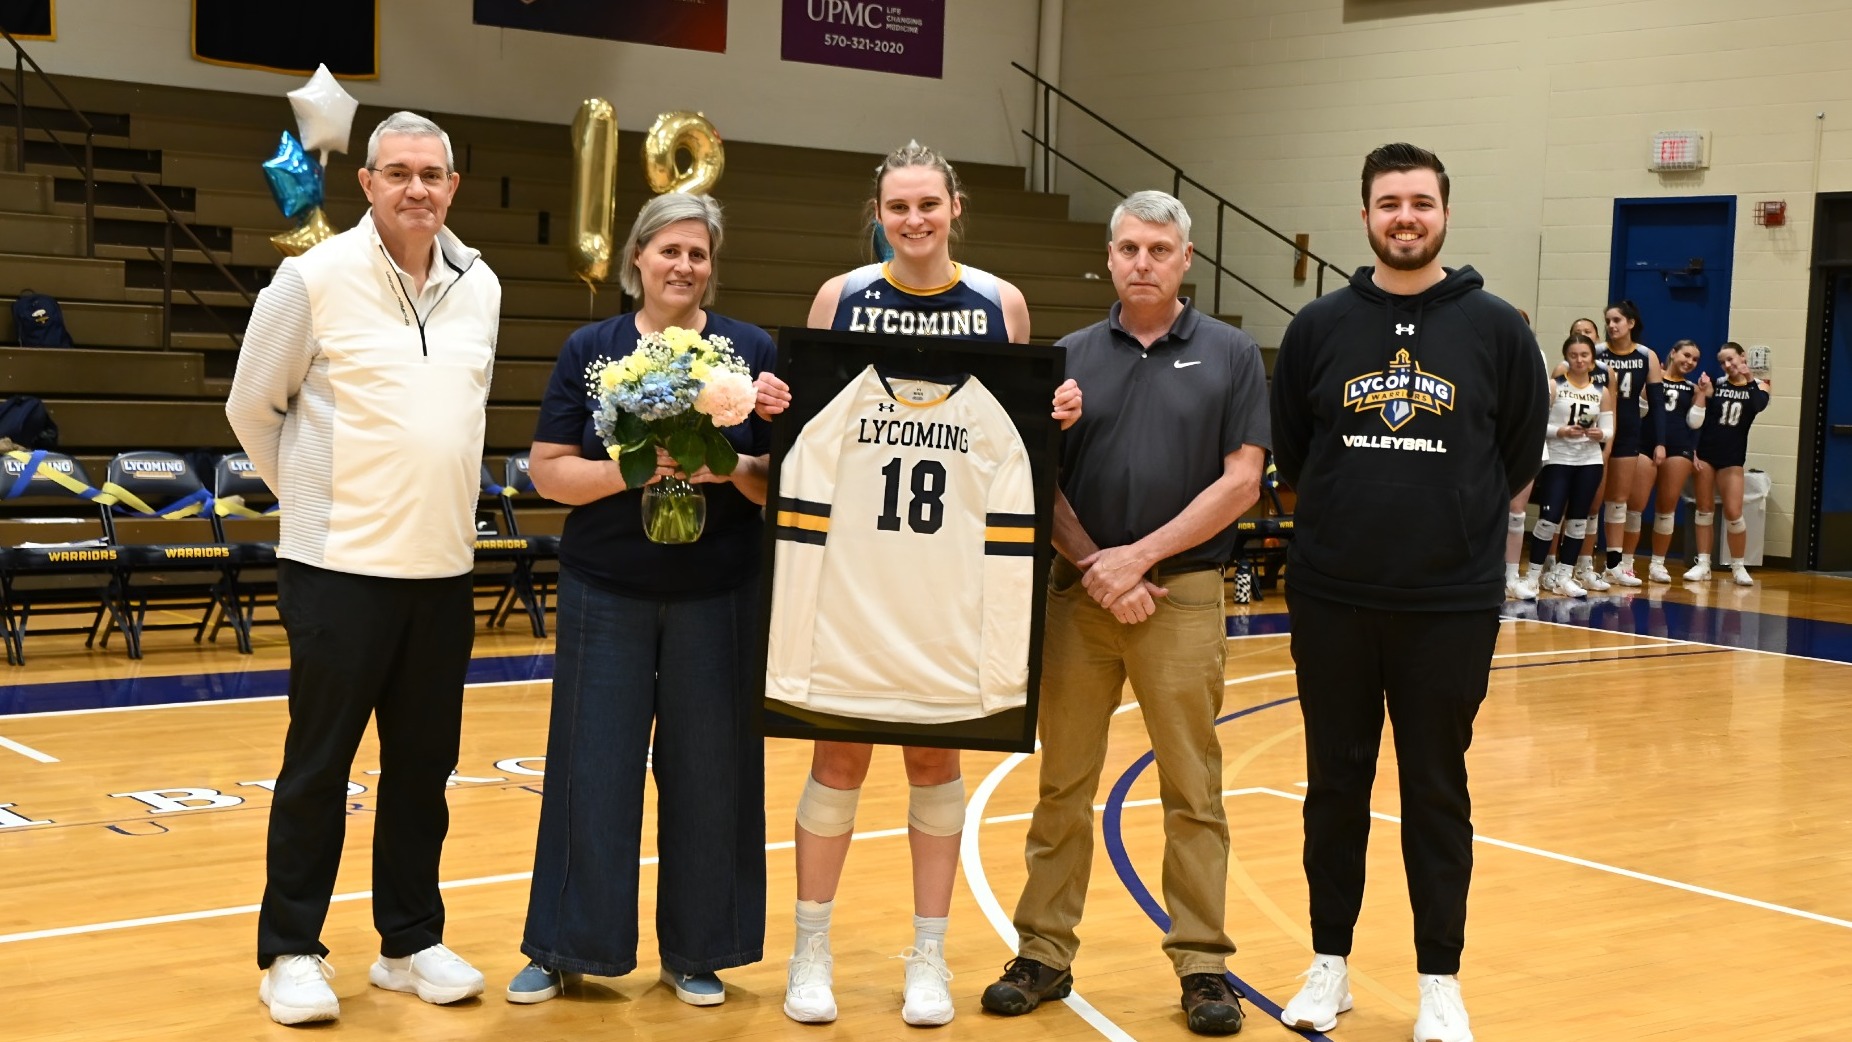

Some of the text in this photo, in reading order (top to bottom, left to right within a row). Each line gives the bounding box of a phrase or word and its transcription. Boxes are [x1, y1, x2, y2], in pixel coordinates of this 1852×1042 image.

[807, 0, 883, 29] UPMC
[886, 6, 902, 15] LIFE
[886, 15, 923, 26] CHANGING
[885, 23, 919, 34] MEDICINE
[824, 33, 904, 55] 570-321-2020
[850, 306, 988, 336] LYCOMING
[1371, 391, 1428, 401] WARRIRS
[1558, 390, 1600, 403] LYCOMING
[1715, 388, 1750, 400] LYCOMIN
[1720, 400, 1742, 426] 10
[858, 418, 969, 454] LYCOMING
[1342, 435, 1447, 453] VOLLEYBALL
[123, 460, 183, 473] LYCOMING
[877, 457, 947, 535] 18
[48, 550, 117, 562] WARRIORS
[165, 547, 229, 559] WARRIORS
